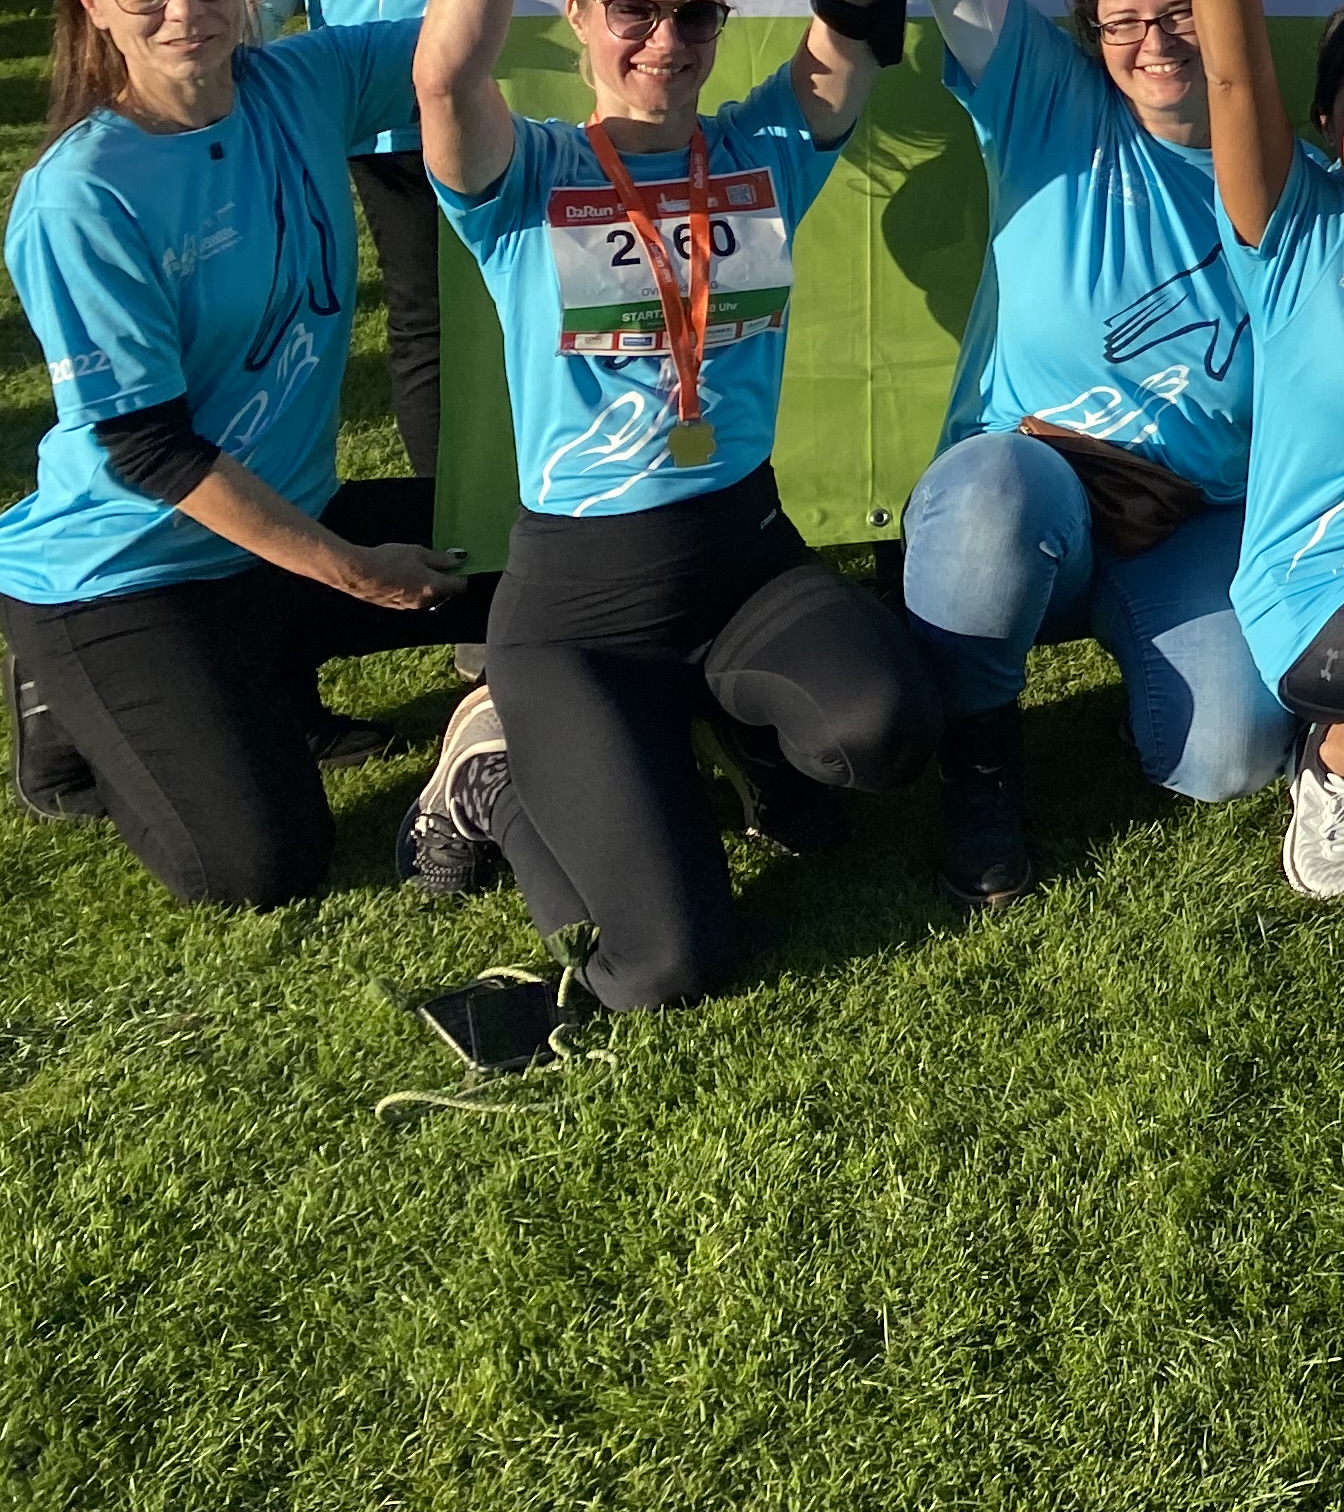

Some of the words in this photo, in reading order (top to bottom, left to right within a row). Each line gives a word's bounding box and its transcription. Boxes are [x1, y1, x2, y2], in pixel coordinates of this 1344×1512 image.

[606, 220, 737, 267] 260
[622, 309, 664, 322] STARTZ
[718, 302, 737, 312] Uhr
[49, 350, 111, 385] 2022
